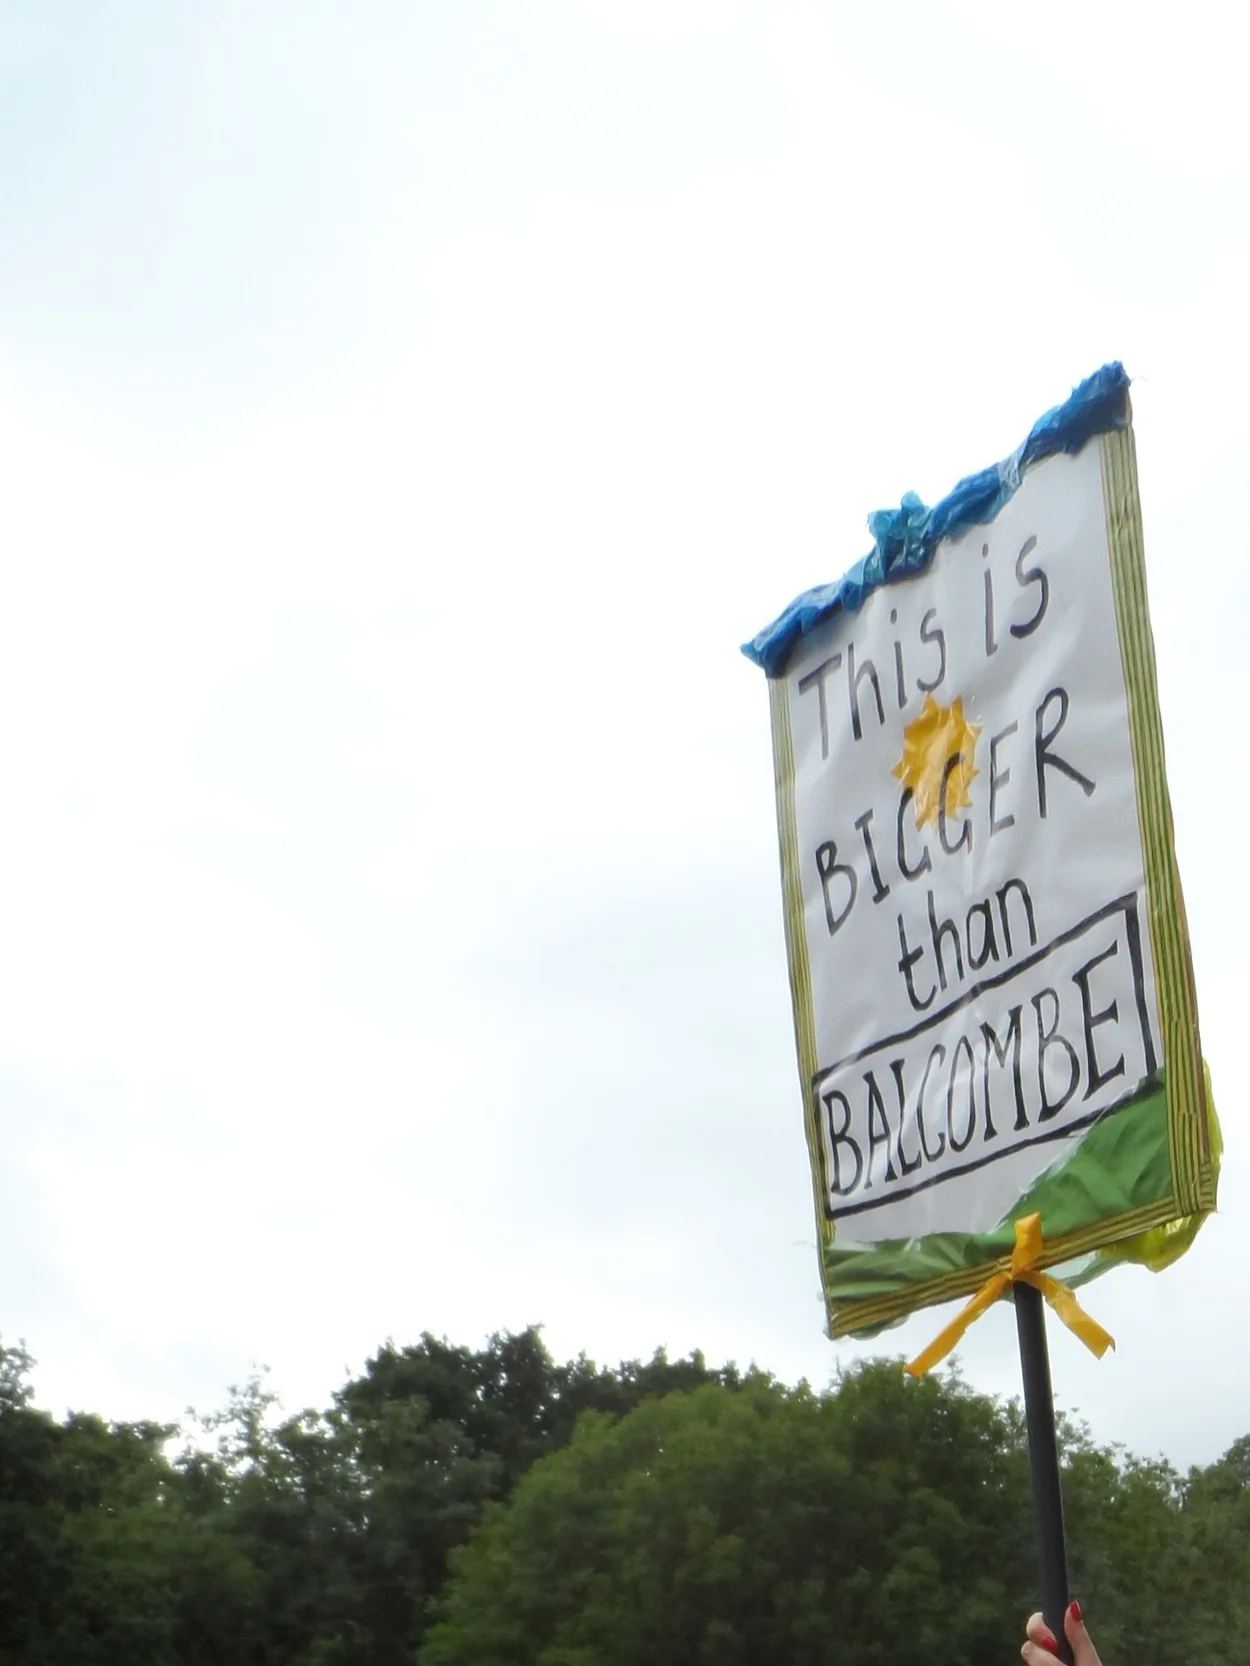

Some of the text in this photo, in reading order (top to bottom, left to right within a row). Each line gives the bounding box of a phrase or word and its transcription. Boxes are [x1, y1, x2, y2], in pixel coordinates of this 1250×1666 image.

[799, 609, 947, 760] This
[815, 686, 1096, 935] BIGGER
[898, 877, 1036, 1011] than
[823, 941, 1126, 1195] BALCOMBE
